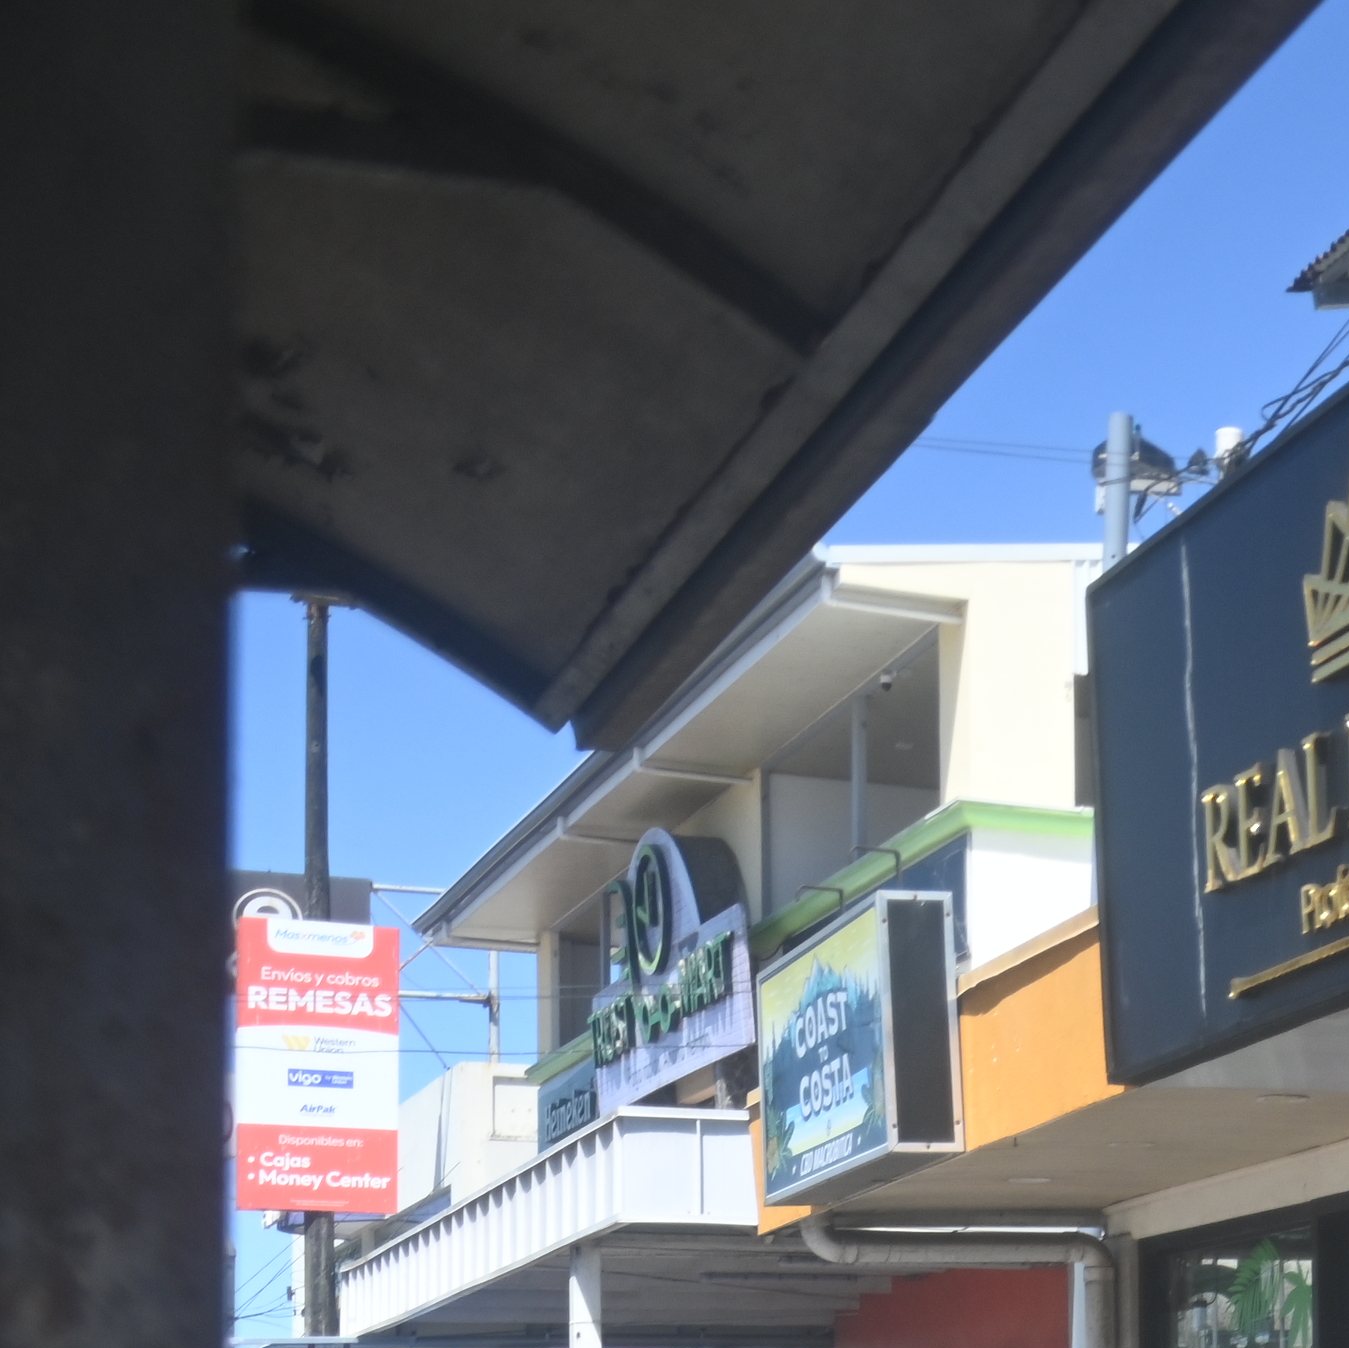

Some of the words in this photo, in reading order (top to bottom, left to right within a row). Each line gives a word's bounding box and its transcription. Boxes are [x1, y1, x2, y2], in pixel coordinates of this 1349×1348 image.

[1201, 732, 1340, 893] REAL
[261, 966, 312, 984] Envíos
[315, 974, 324, 987] y
[327, 972, 380, 988] cobros
[248, 986, 393, 1017] REMESAS
[795, 990, 848, 1059] COAST
[315, 1036, 356, 1047] Western
[818, 1046, 829, 1062] TO
[289, 1071, 322, 1086] vigo
[800, 1053, 855, 1121] COSTA
[545, 1090, 591, 1141] Heineken
[278, 1134, 345, 1148] Disponibles
[346, 1138, 363, 1148] en:
[260, 1152, 311, 1171] Cajas
[258, 1169, 324, 1190] Money
[326, 1171, 391, 1189] Center
